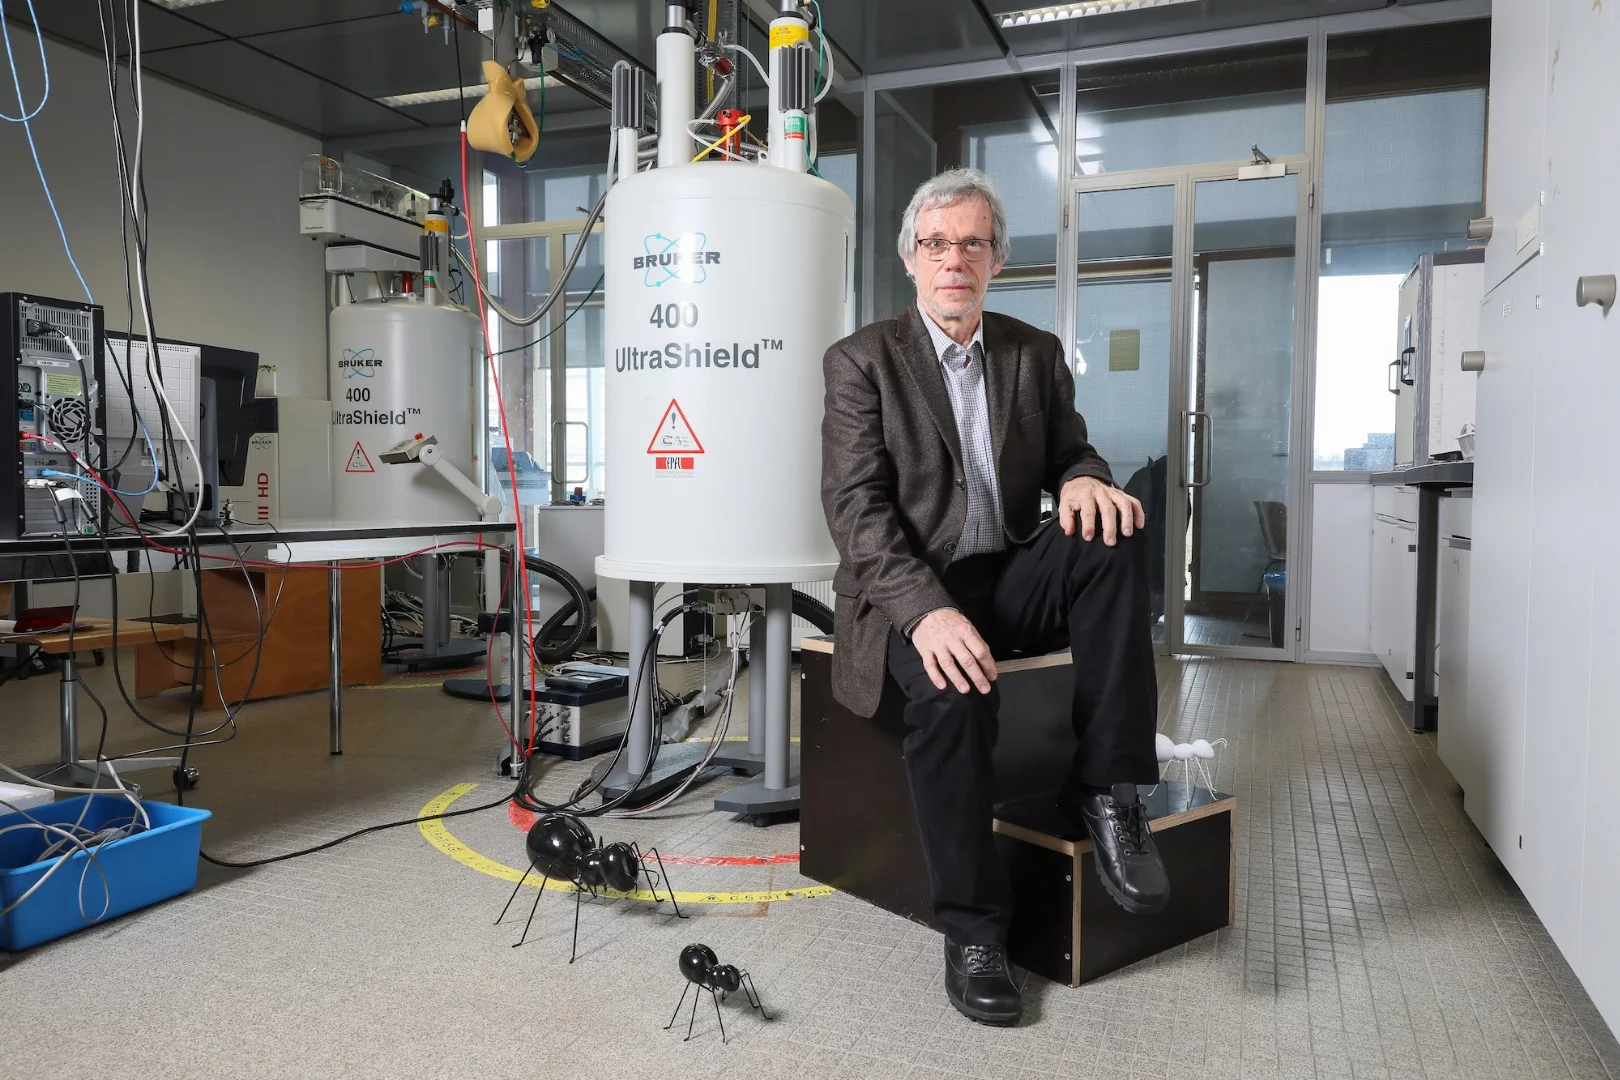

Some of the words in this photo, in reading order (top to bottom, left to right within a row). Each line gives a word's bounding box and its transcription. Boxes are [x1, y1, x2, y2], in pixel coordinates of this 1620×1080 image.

[649, 302, 699, 329] 400
[338, 359, 383, 368] BRUKER
[345, 387, 371, 402] 400
